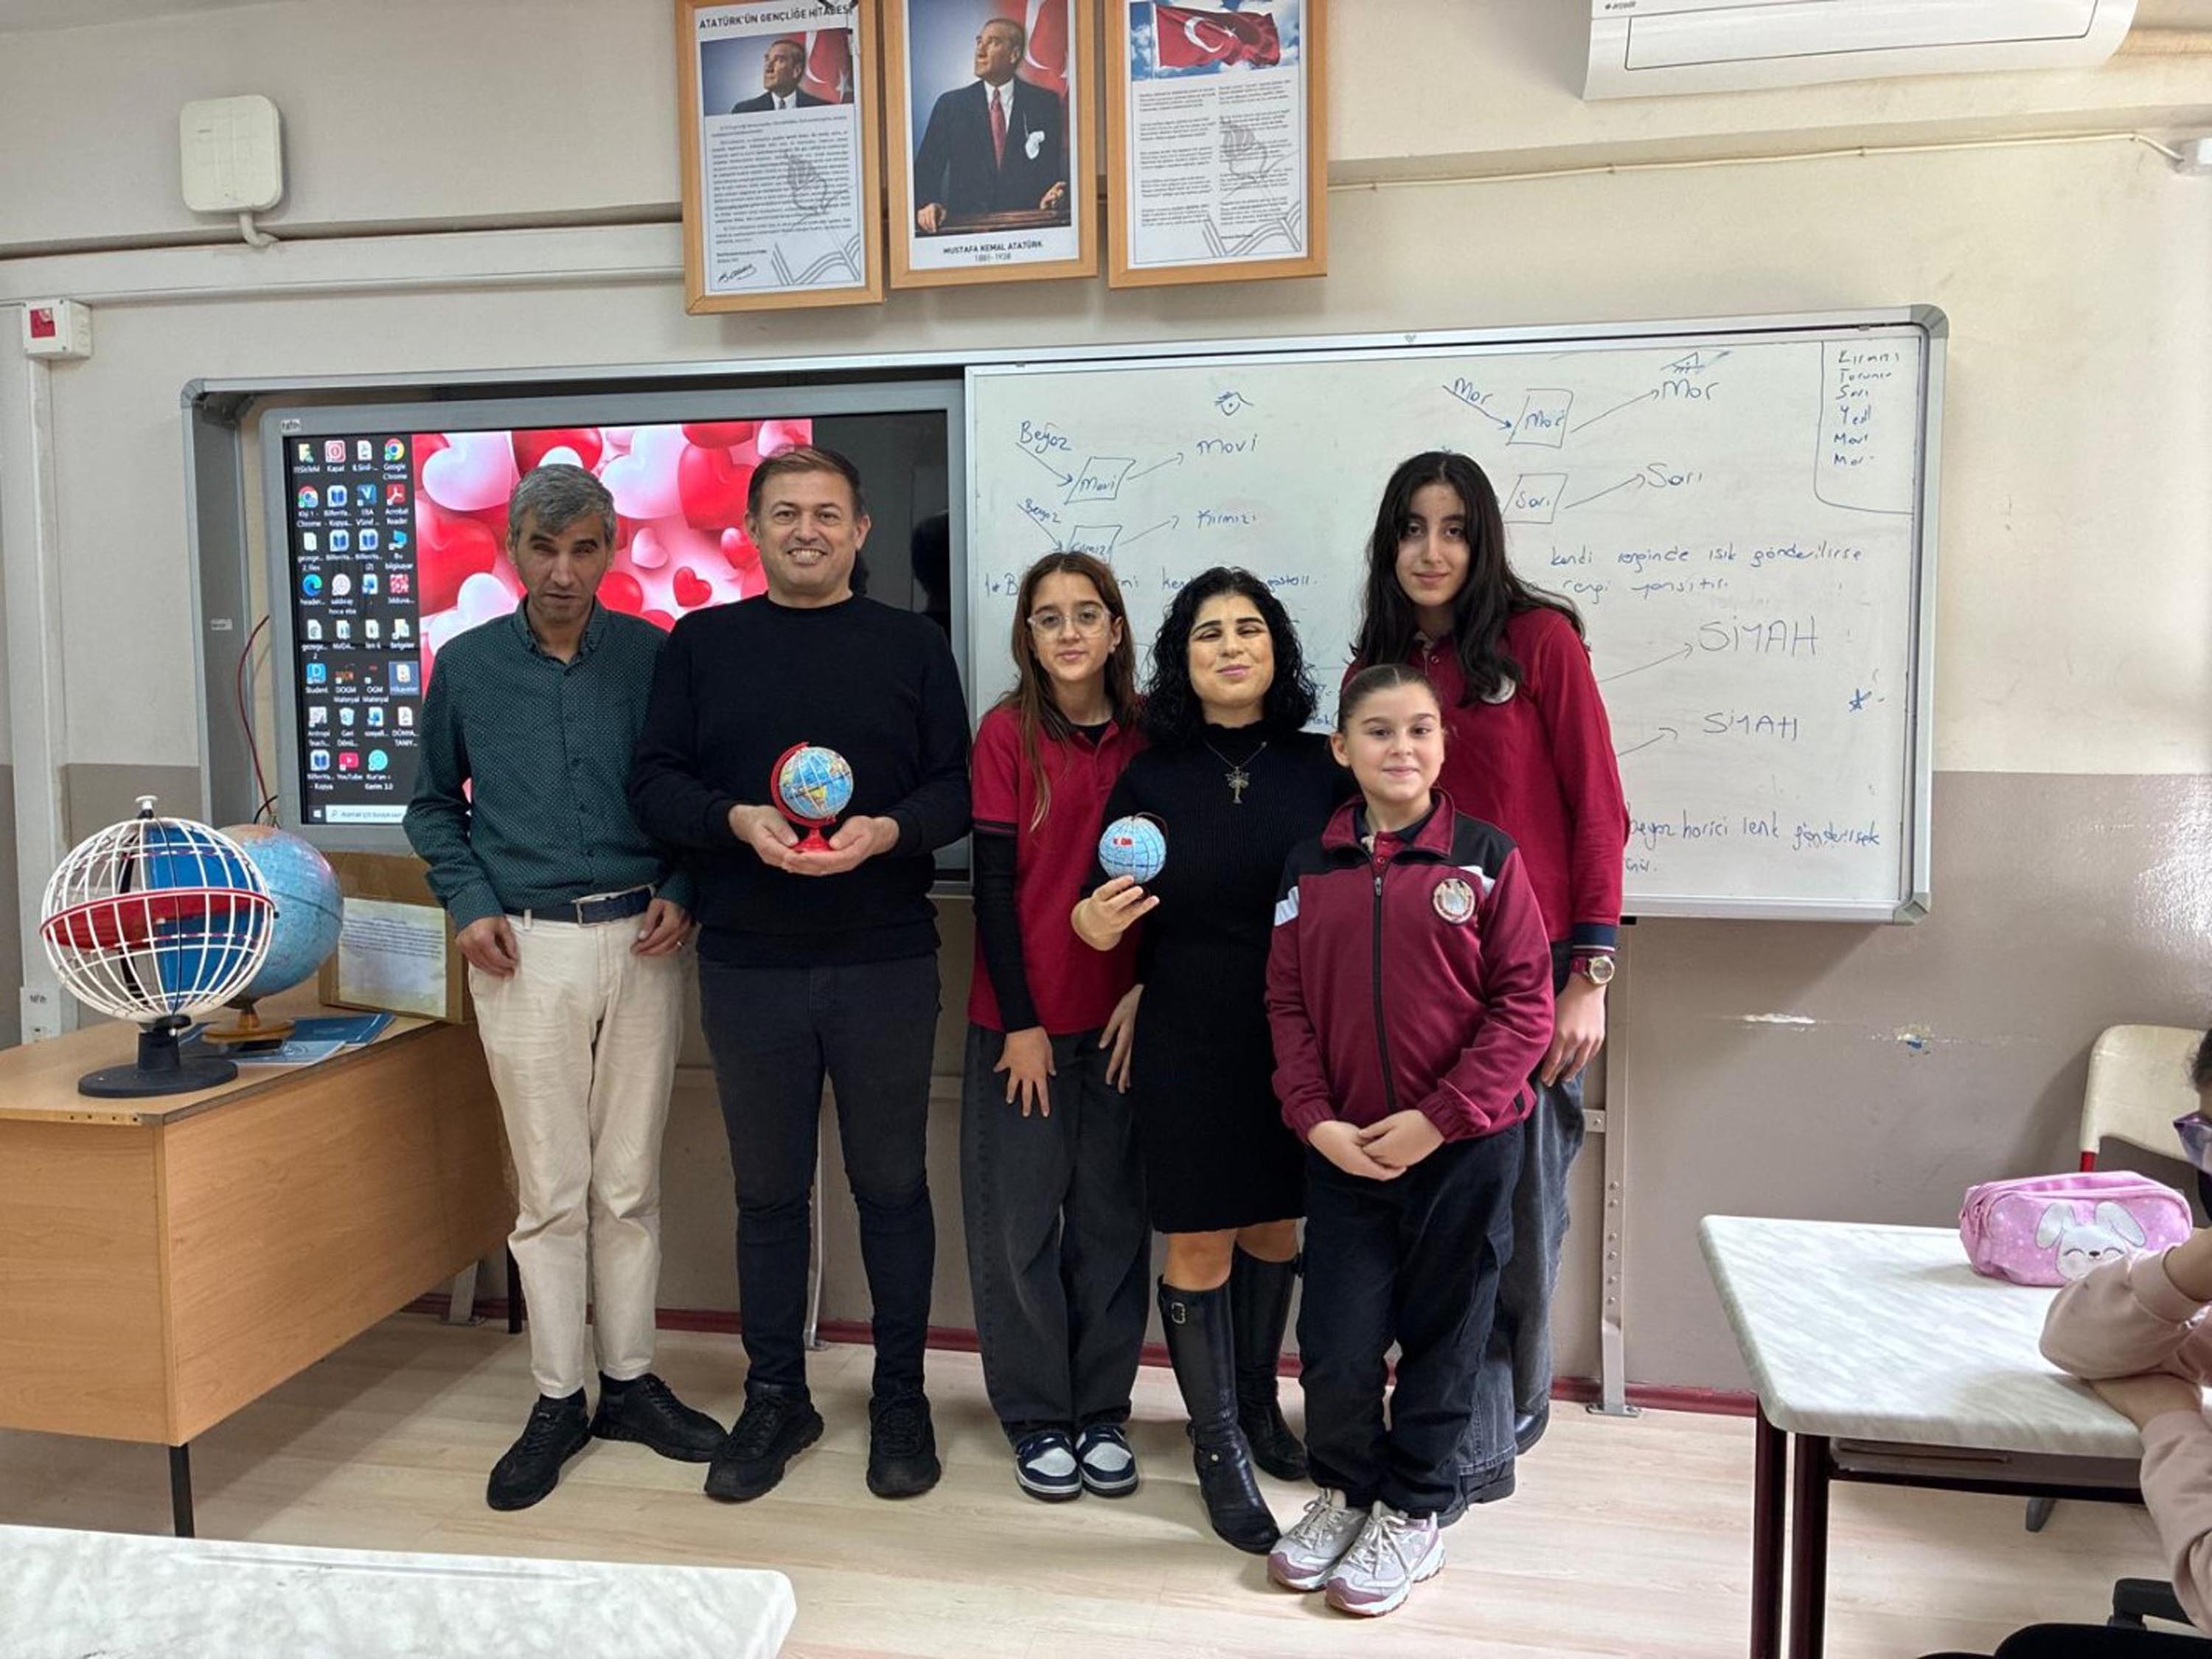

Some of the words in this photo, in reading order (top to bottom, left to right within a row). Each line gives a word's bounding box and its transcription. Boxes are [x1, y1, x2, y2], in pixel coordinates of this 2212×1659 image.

[943, 245, 978, 255] MUSTAFA
[980, 243, 1006, 252] KEMAL
[1007, 239, 1043, 250] ATATÜRK
[1454, 377, 1494, 406] Mor
[1663, 378, 1719, 402] Mor
